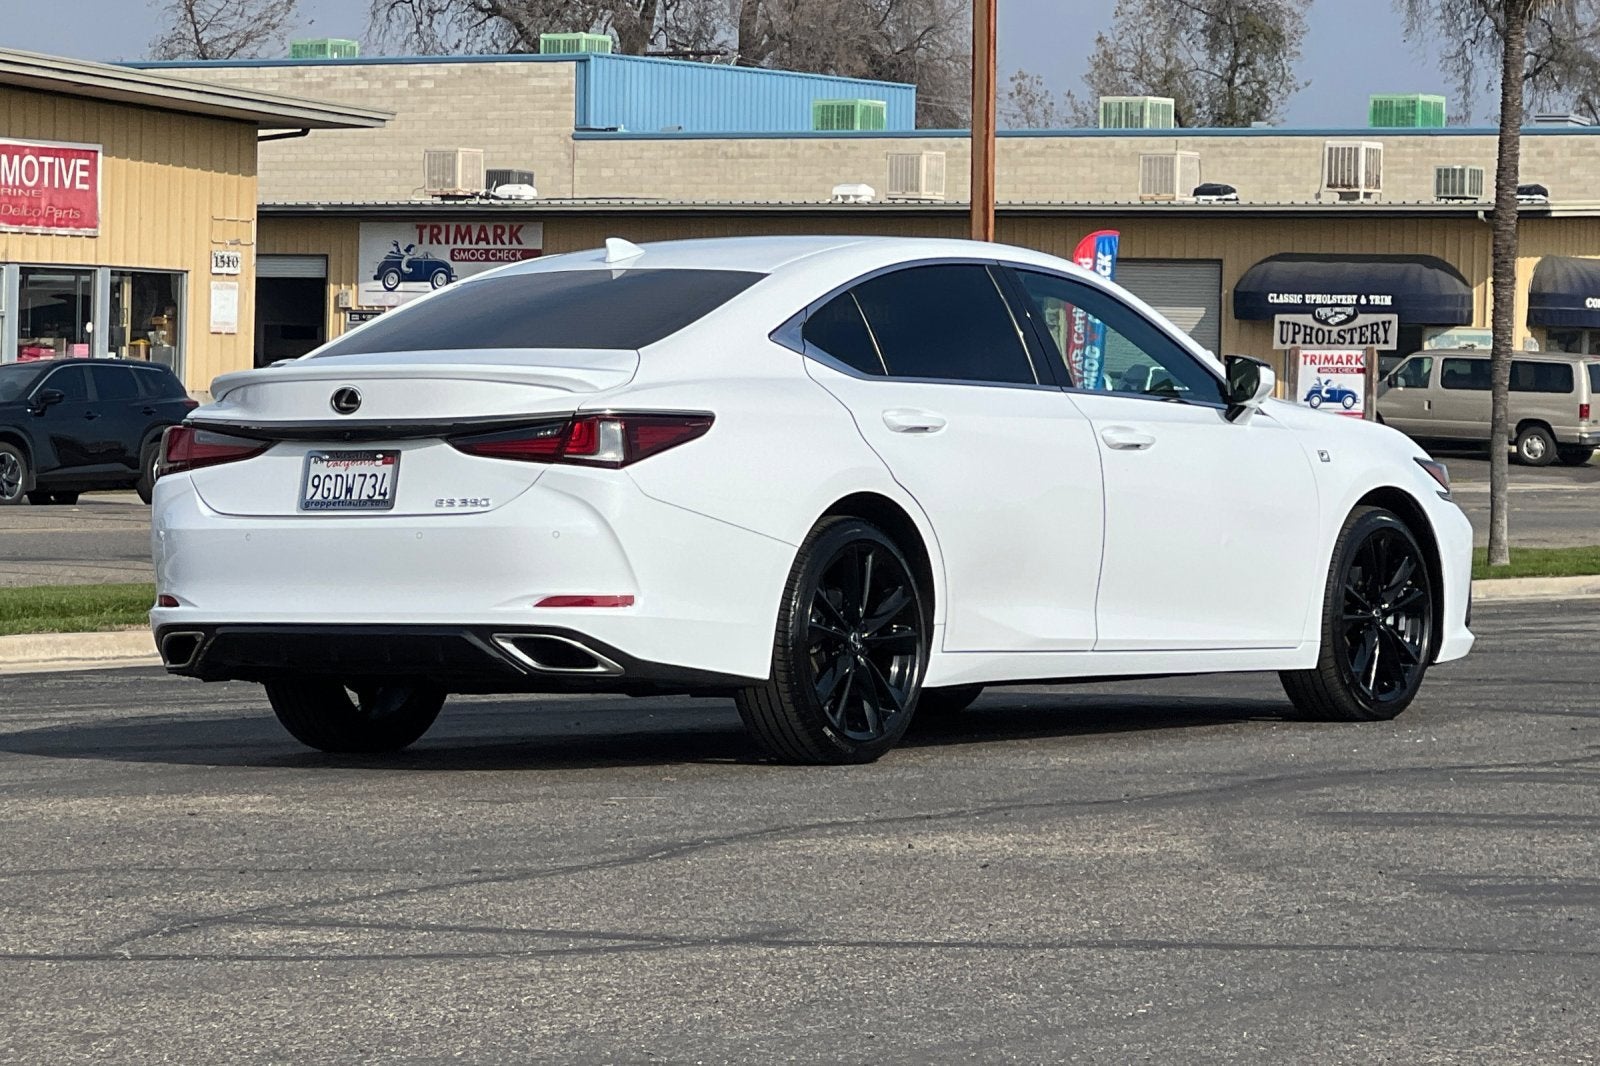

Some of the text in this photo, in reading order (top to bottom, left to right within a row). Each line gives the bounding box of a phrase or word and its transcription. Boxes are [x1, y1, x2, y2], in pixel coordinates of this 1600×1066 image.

[0, 153, 90, 190] MOTIVE
[1, 203, 80, 219] Delco Parts
[415, 224, 524, 245] TRIMARK
[214, 254, 239, 268] 1540
[453, 249, 522, 260] SMOG CHECK
[1268, 293, 1392, 305] CLASSIC UPHOLSTERY & TRIM
[1279, 320, 1392, 345] UPHOLSTERY
[1302, 354, 1364, 366] TRIMARK
[309, 473, 388, 500] 9GDW734
[304, 500, 389, 508] groppettiauto.com
